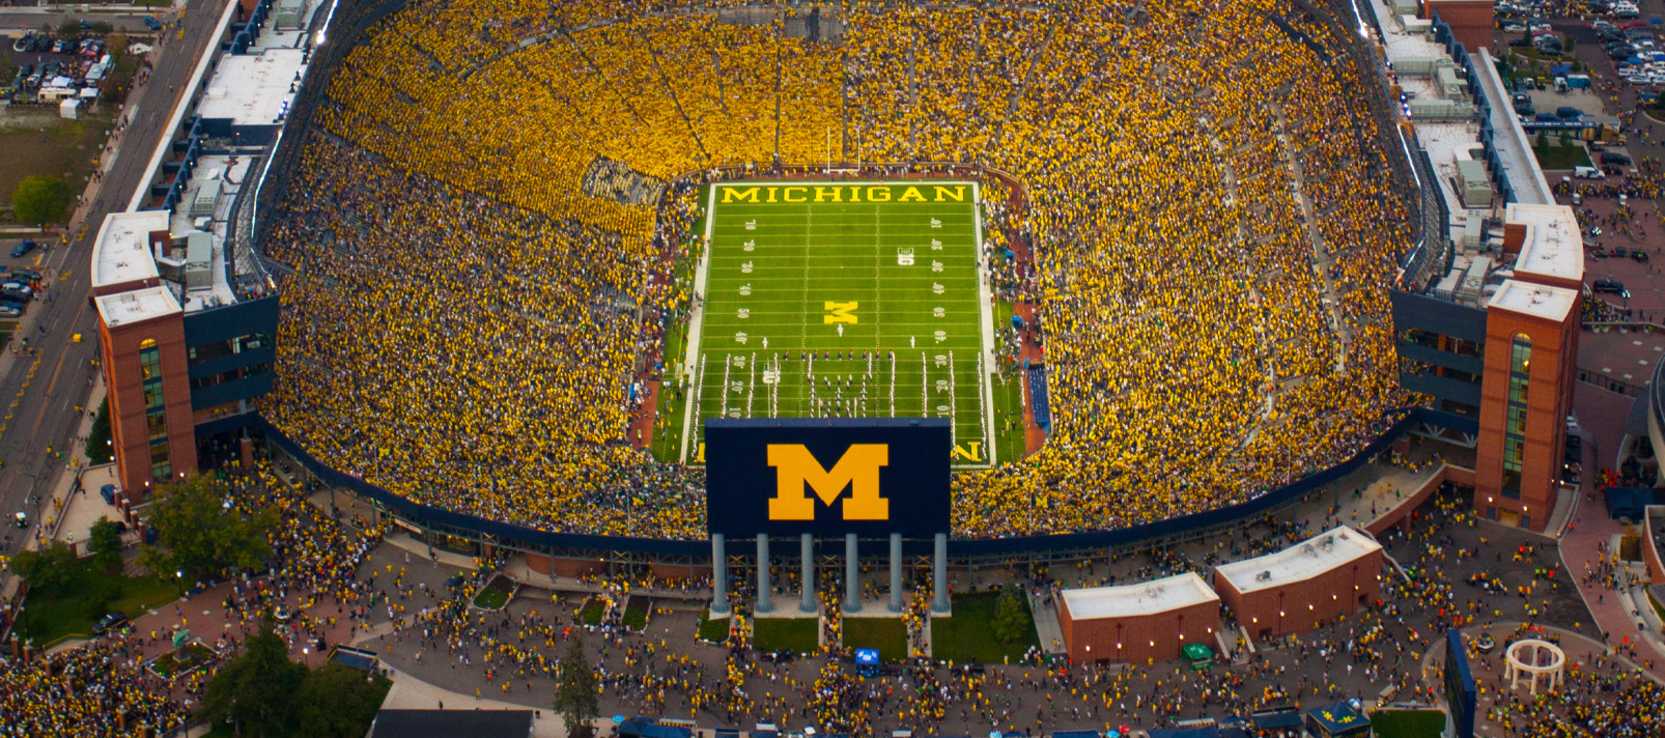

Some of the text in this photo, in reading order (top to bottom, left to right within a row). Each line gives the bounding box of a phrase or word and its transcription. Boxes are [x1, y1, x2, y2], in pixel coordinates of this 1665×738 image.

[720, 186, 966, 203] MICHIGAN
[823, 301, 859, 325] M
[767, 444, 889, 521] M
